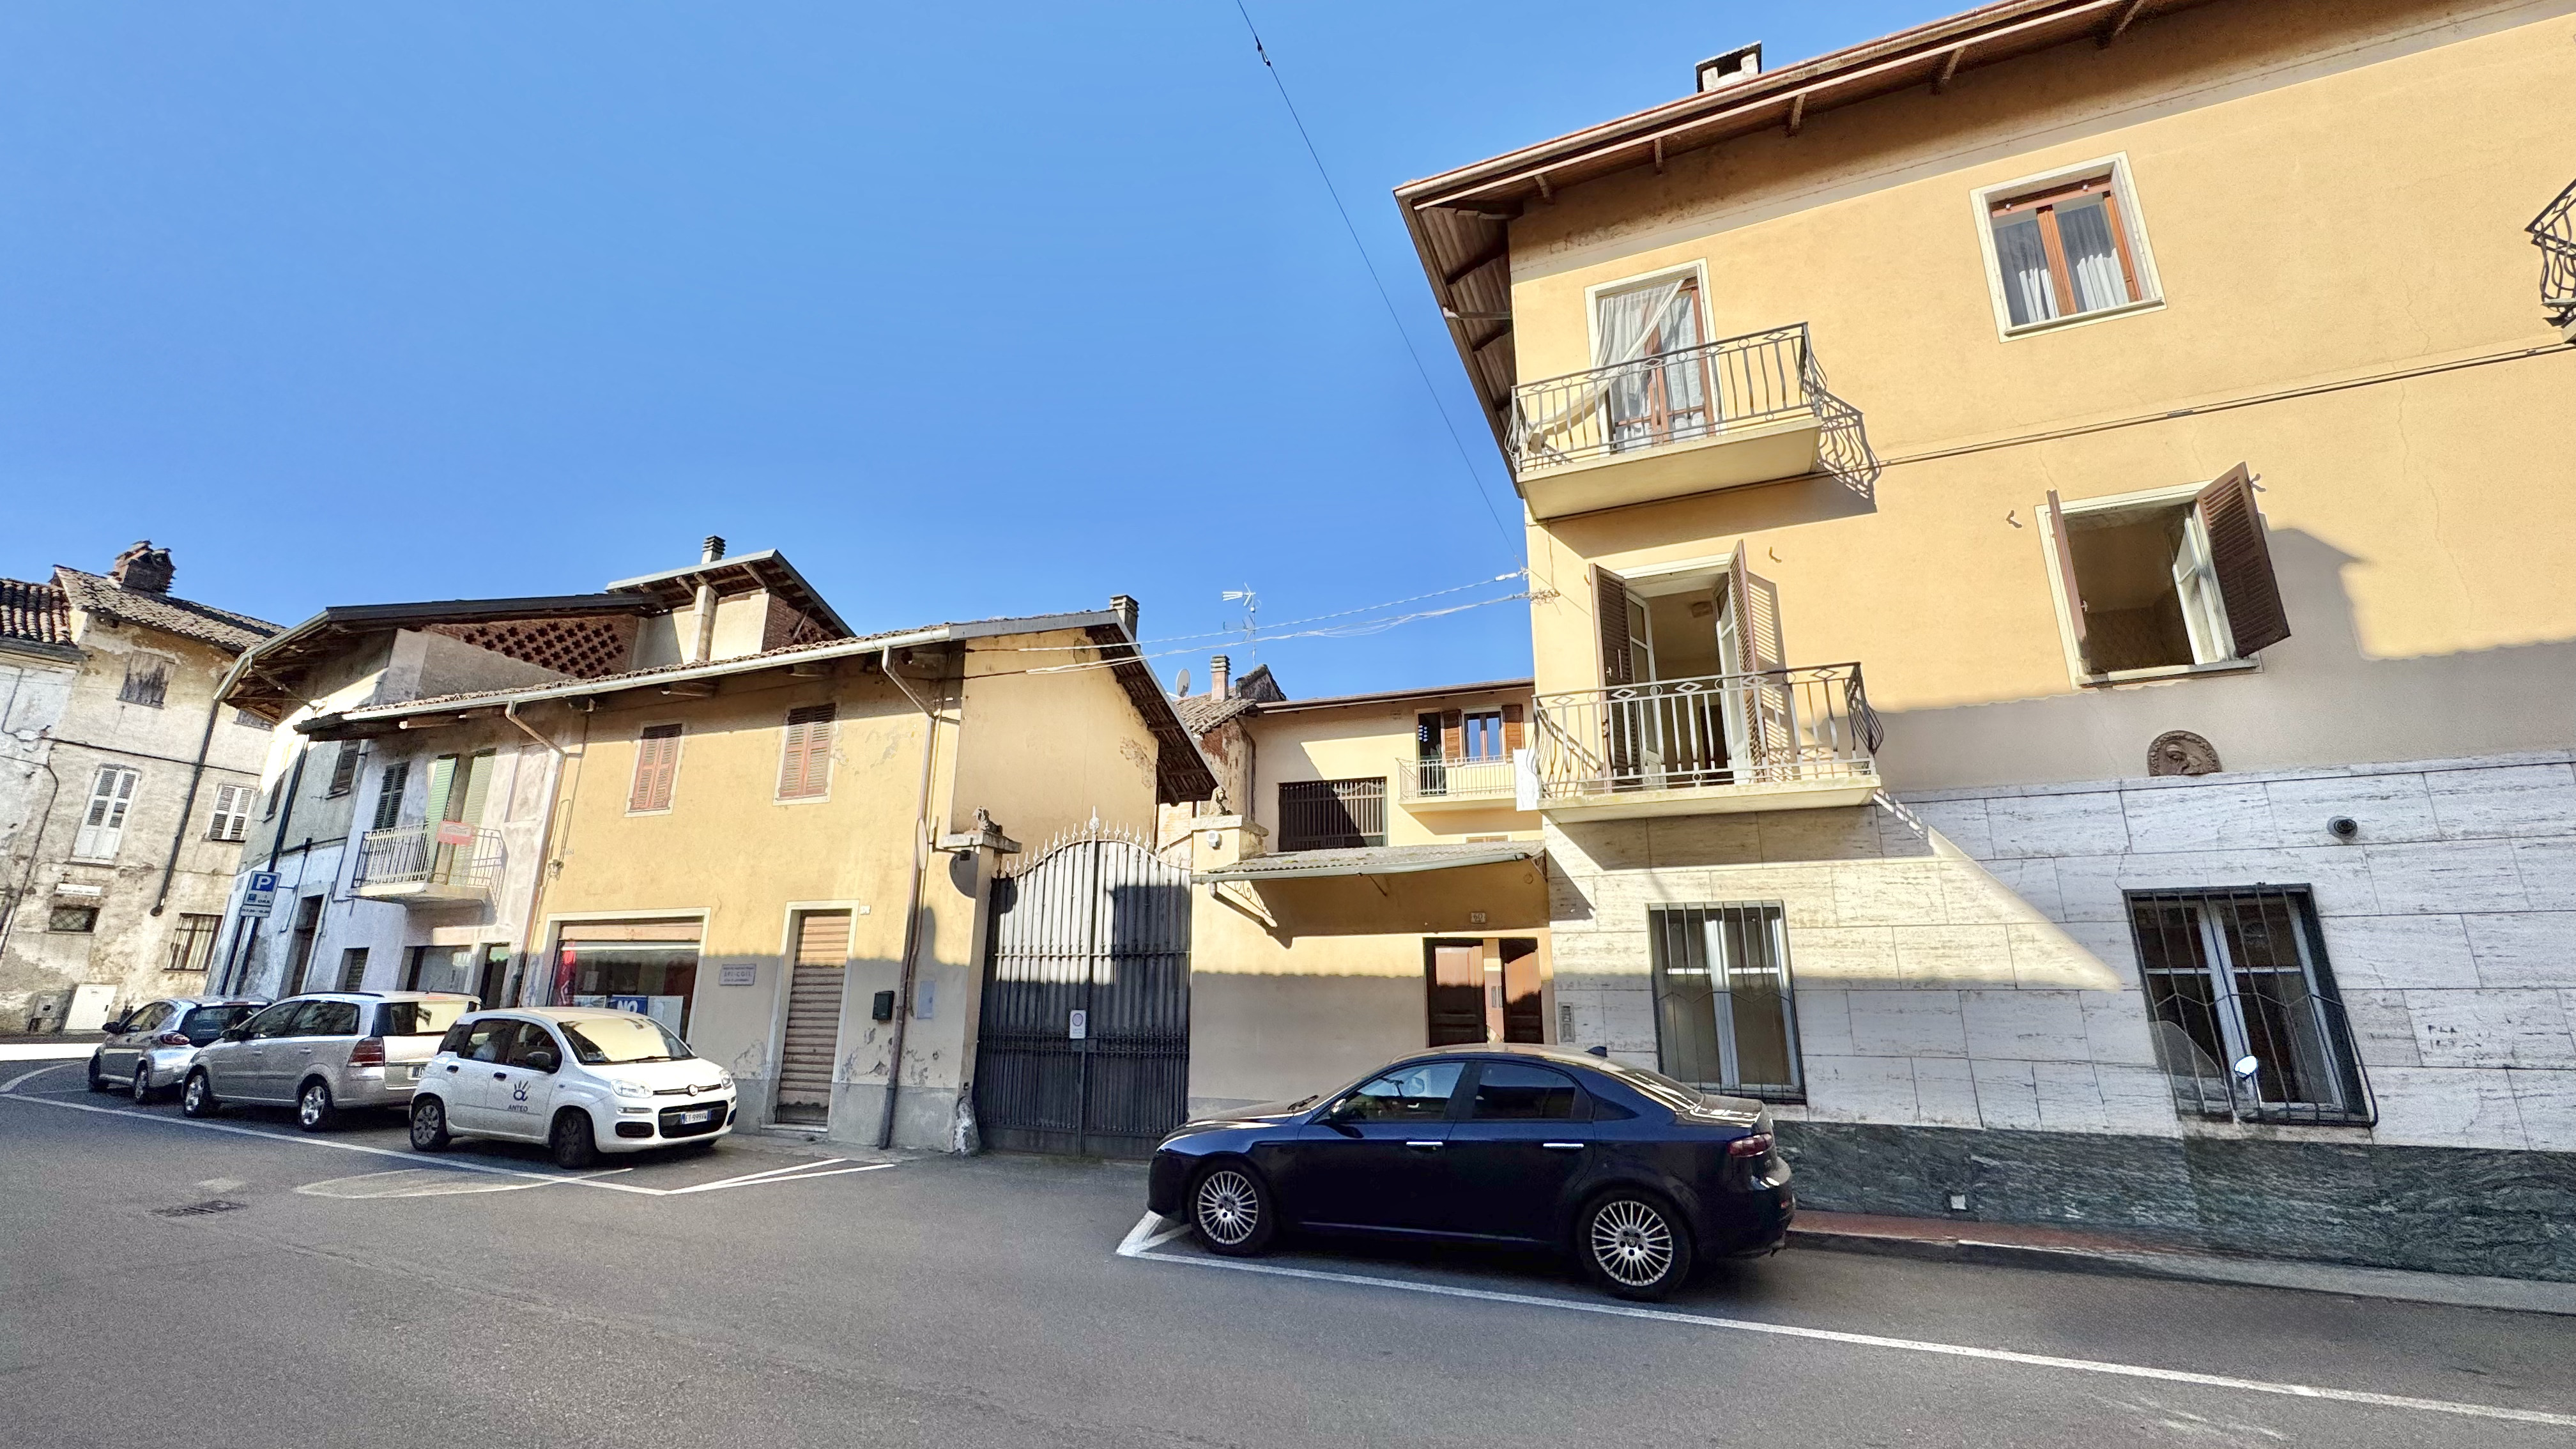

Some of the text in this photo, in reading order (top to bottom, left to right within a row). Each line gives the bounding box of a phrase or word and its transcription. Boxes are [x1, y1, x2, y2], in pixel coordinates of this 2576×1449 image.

[256, 875, 272, 889] P
[617, 1000, 638, 1013] NO
[507, 1104, 528, 1112] ANTEO
